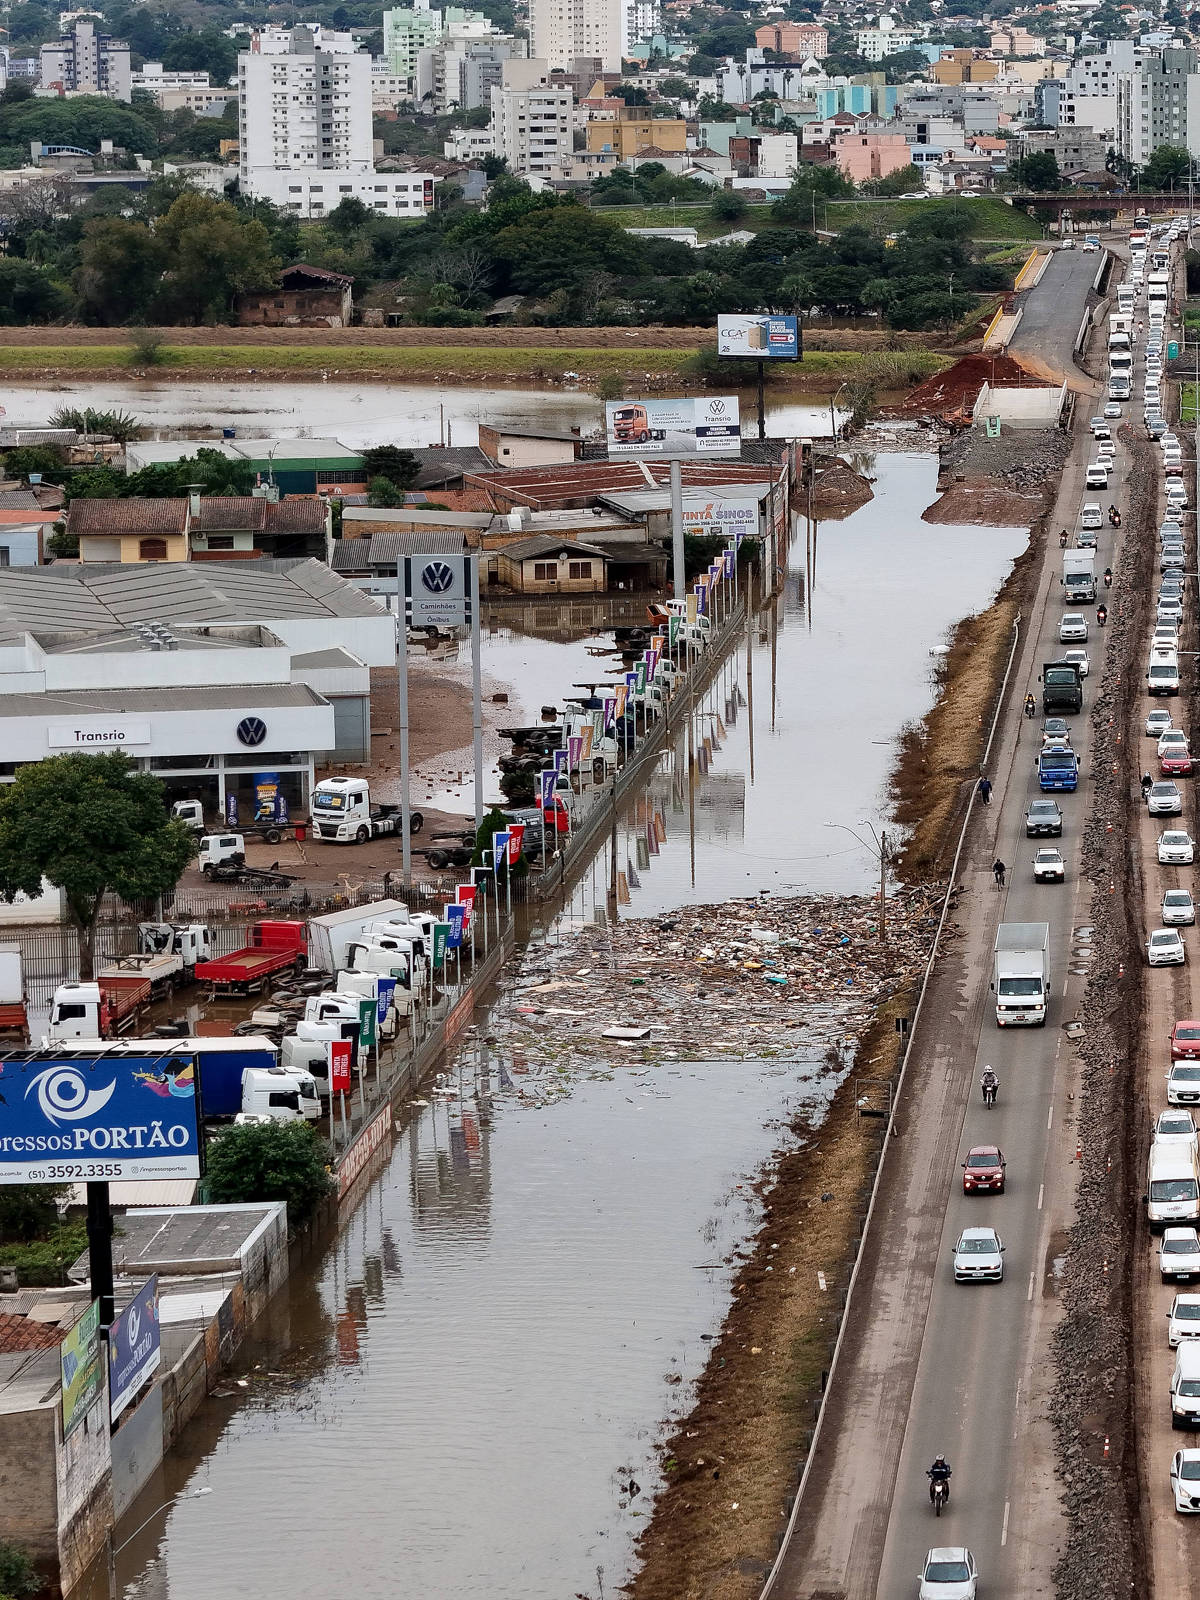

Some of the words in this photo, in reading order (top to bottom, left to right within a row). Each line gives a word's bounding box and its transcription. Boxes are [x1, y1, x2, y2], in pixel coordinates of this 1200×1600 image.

[715, 509, 754, 519] SINOS
[74, 730, 125, 741] Transrio
[437, 934, 445, 958] GARANTIA
[333, 1056, 341, 1076] PRONTA
[0, 1120, 190, 1152] ressosPORTÃO
[28, 1170, 46, 1179] (51)
[47, 1164, 122, 1178] 3592.3355
